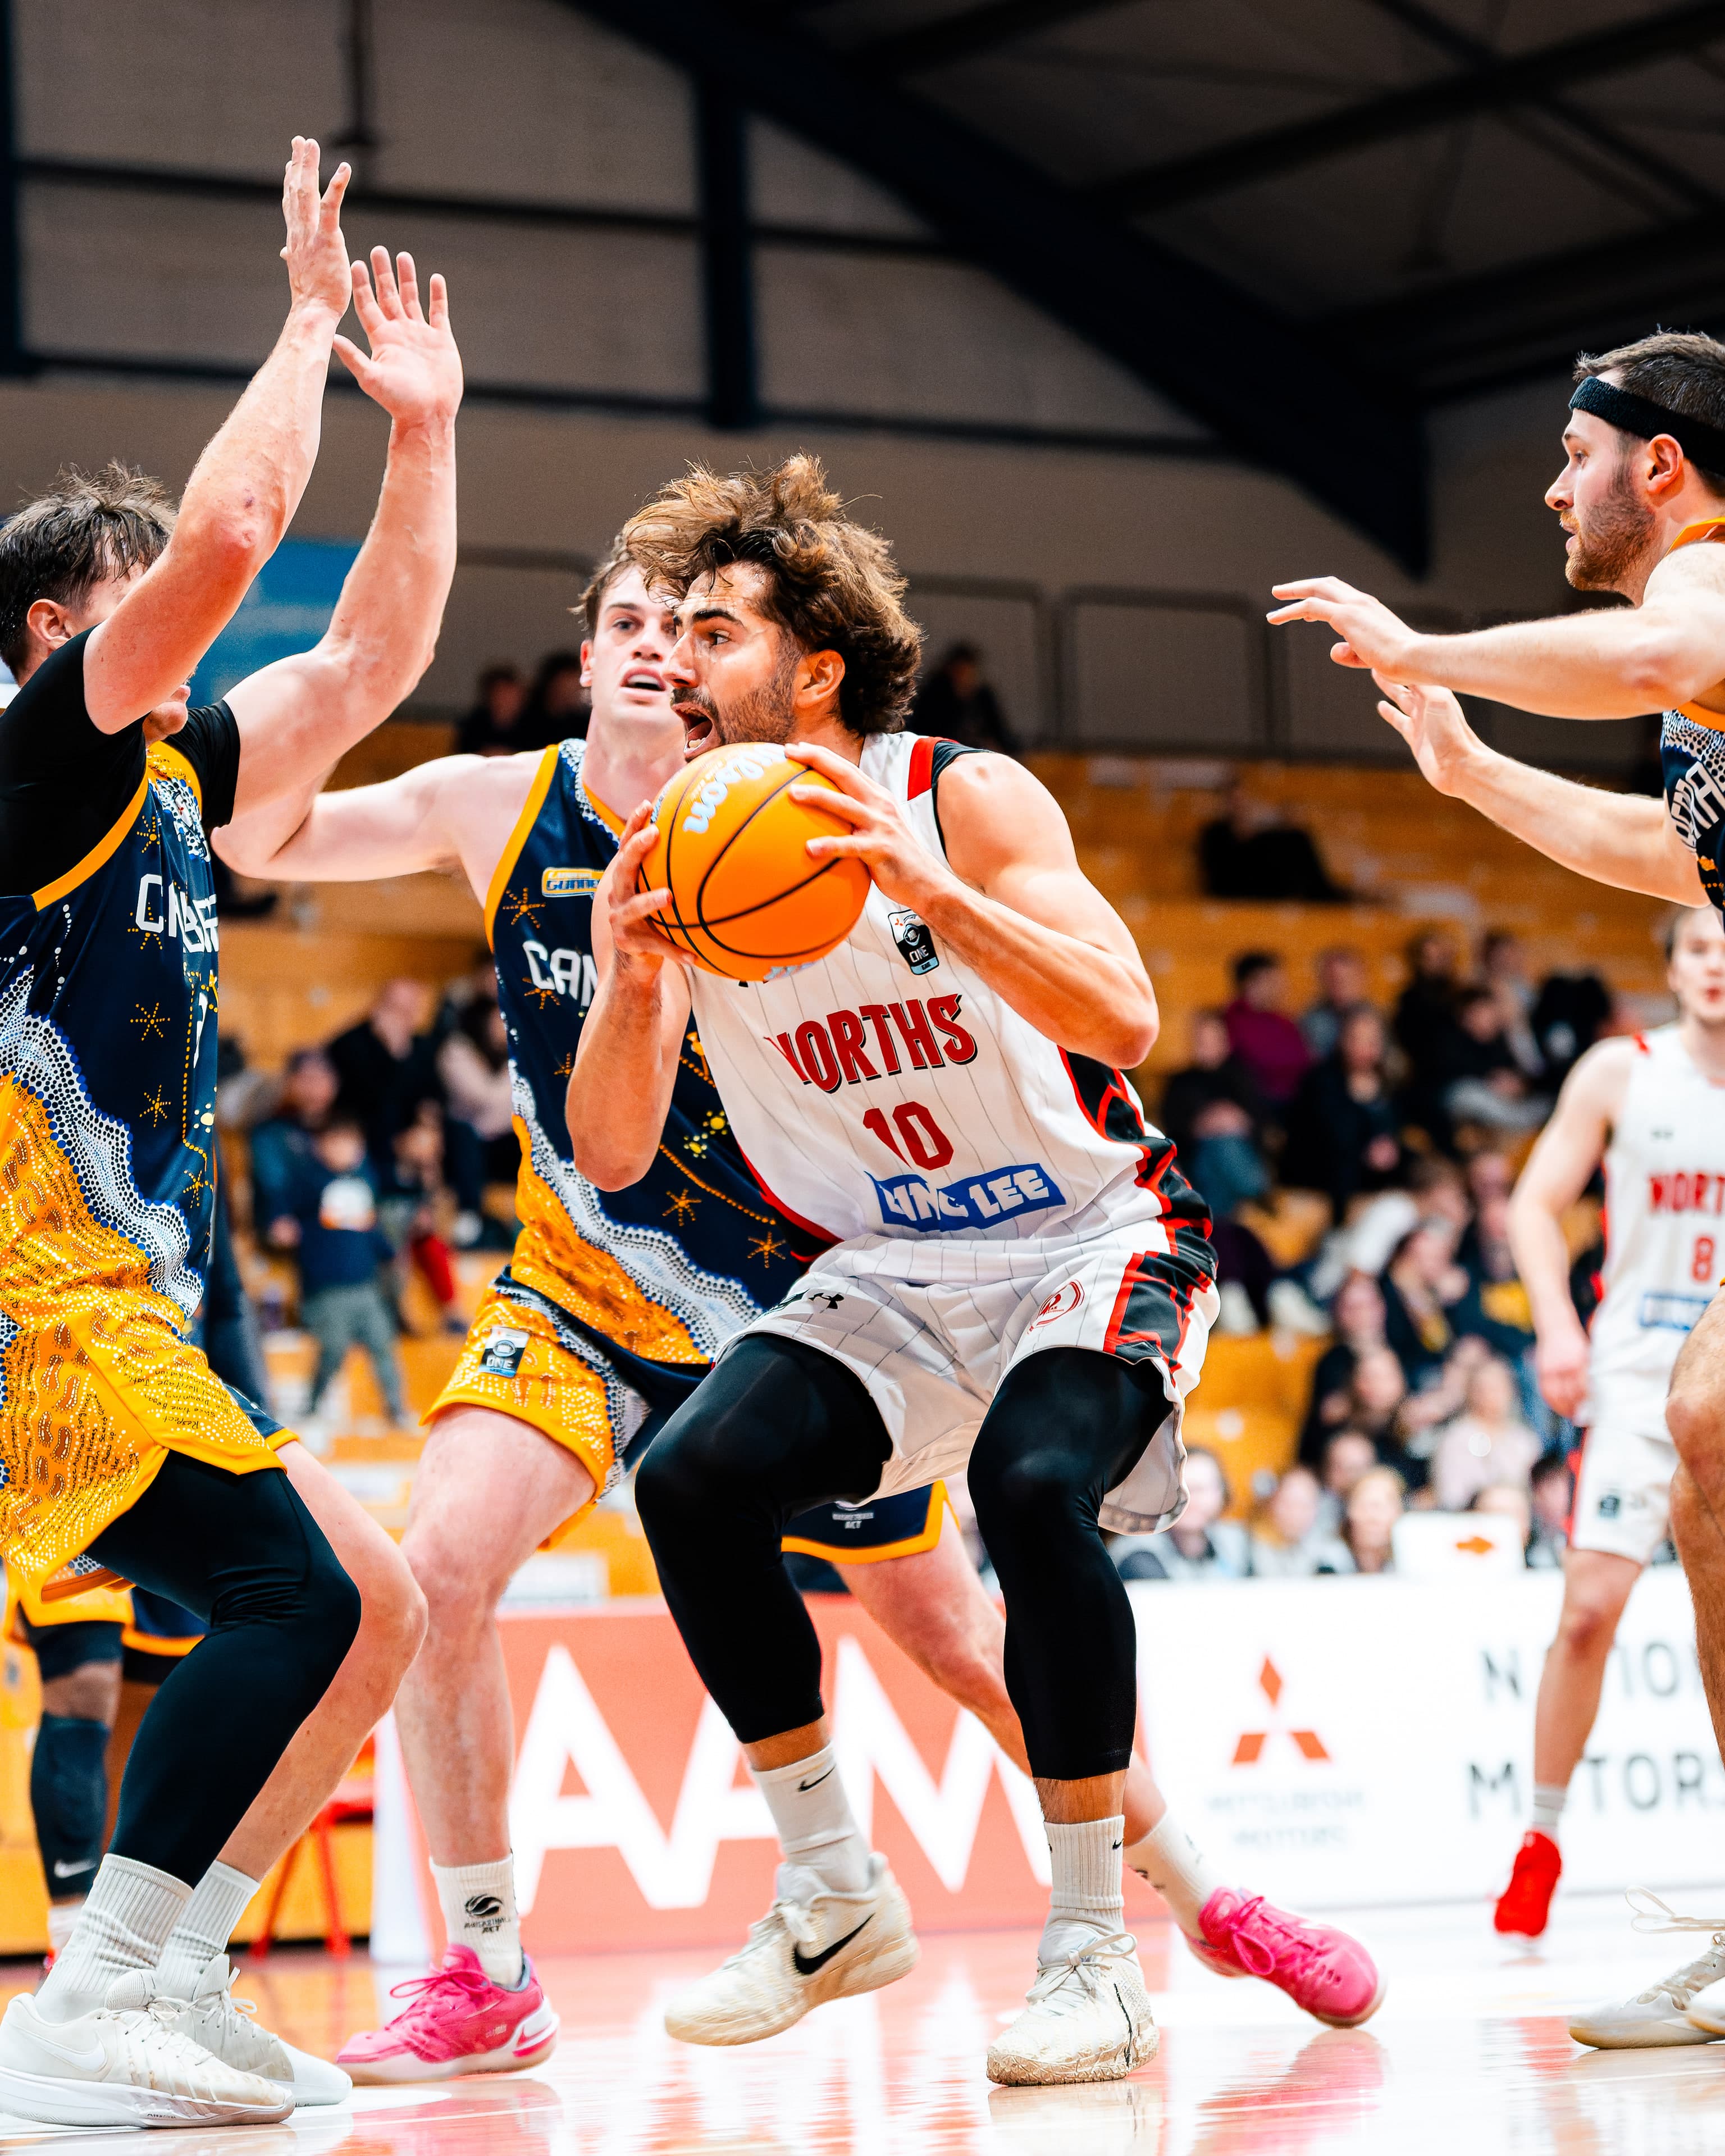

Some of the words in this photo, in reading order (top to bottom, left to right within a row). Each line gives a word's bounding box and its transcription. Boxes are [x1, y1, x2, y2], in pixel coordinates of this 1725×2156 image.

[13, 1085, 28, 1101] Sites
[28, 1098, 45, 1129] Sacred
[22, 1111, 54, 1170] Understanding
[862, 1101, 954, 1171] 10
[969, 1169, 1049, 1219] LEE
[1, 1209, 12, 1234] Unity
[1692, 1236, 1714, 1282] 8
[118, 1355, 143, 1373] Unity
[486, 1354, 514, 1369] ONE
[163, 1415, 199, 1429] Respect
